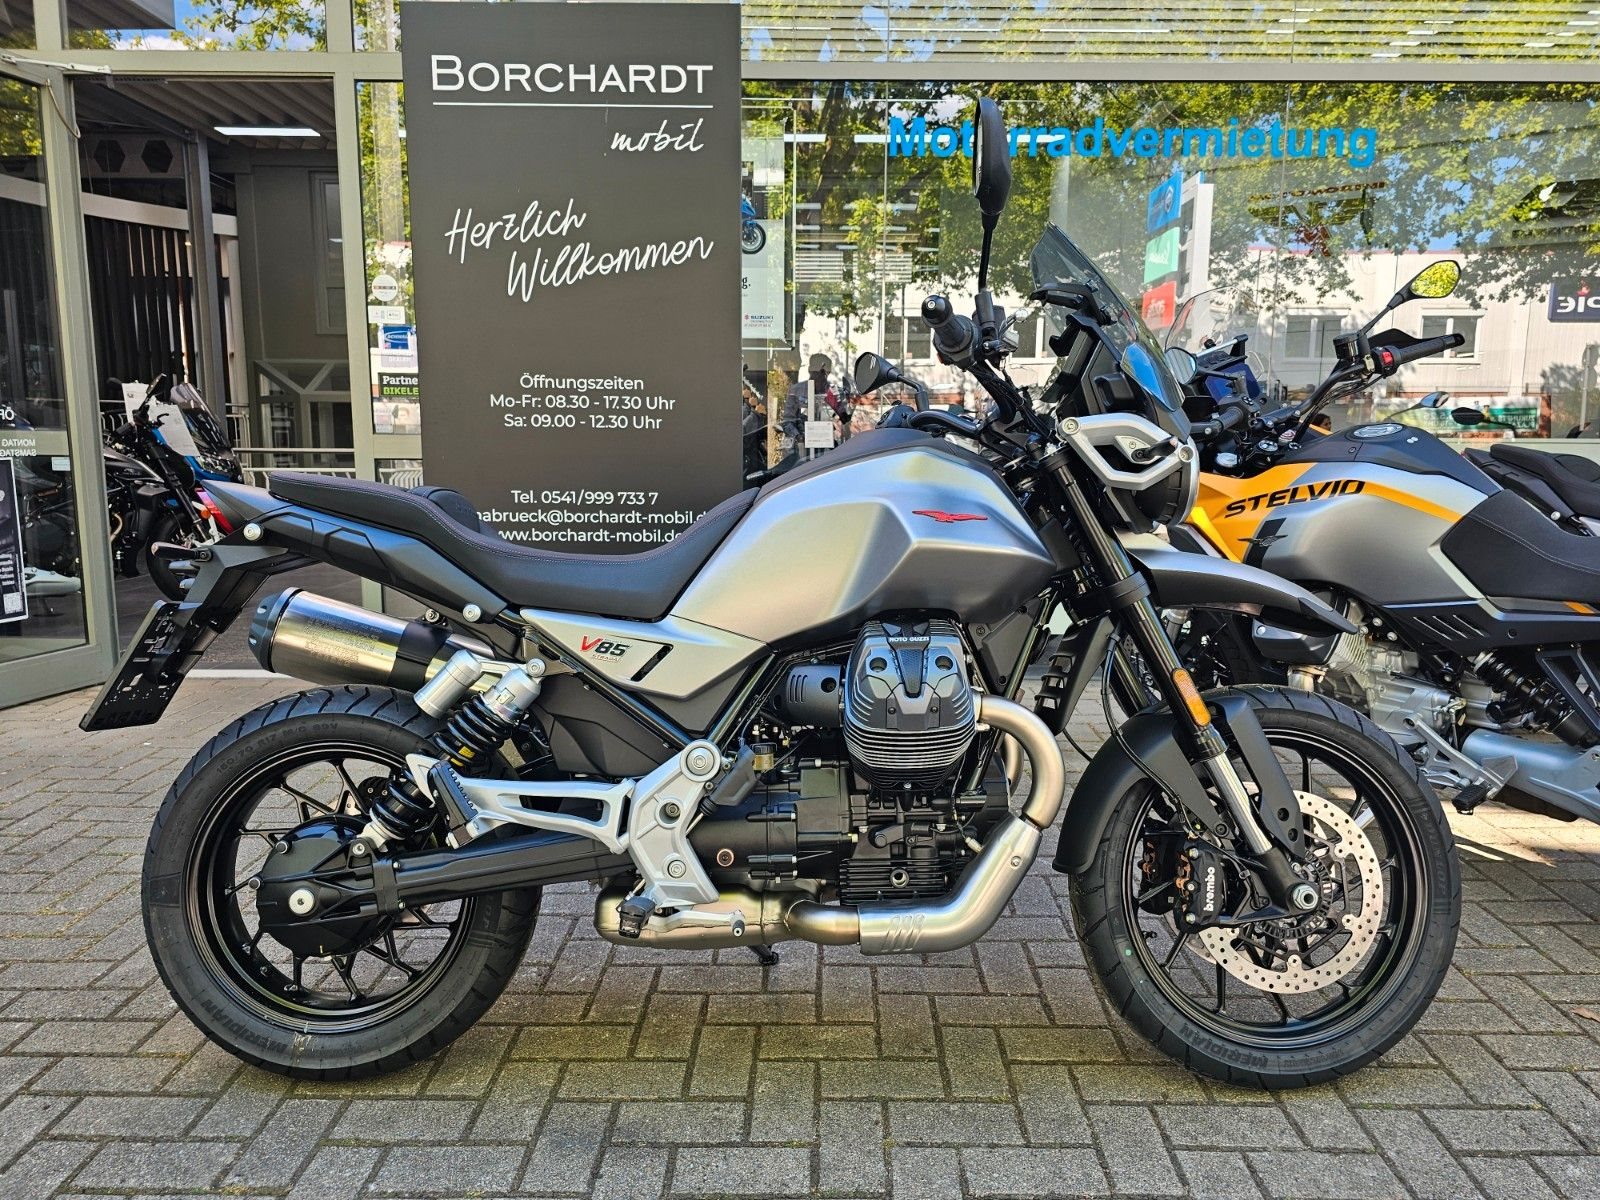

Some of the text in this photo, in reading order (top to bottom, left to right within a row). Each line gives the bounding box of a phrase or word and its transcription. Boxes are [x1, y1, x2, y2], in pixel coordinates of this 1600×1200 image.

[431, 54, 714, 94] BORCHARDT
[610, 117, 705, 152] mobil
[888, 116, 1377, 168] Motrradvermietung
[444, 197, 588, 265] Herzlich
[506, 235, 715, 303] Willkommen
[519, 372, 644, 393] Öffnungszeiten
[490, 393, 542, 408] Mo-Fr:
[545, 394, 590, 409] 08.30
[603, 395, 642, 410] 17.30
[645, 396, 676, 411] Uhr
[504, 413, 527, 428] Sa:
[530, 414, 576, 429] 09.00
[588, 414, 629, 429] 12.30
[632, 415, 663, 430] Uhr
[510, 489, 659, 505] Tel. 0541/999 733 7
[1224, 479, 1366, 518] STELVIO
[580, 635, 630, 657] V85
[1203, 866, 1216, 912] brembo
